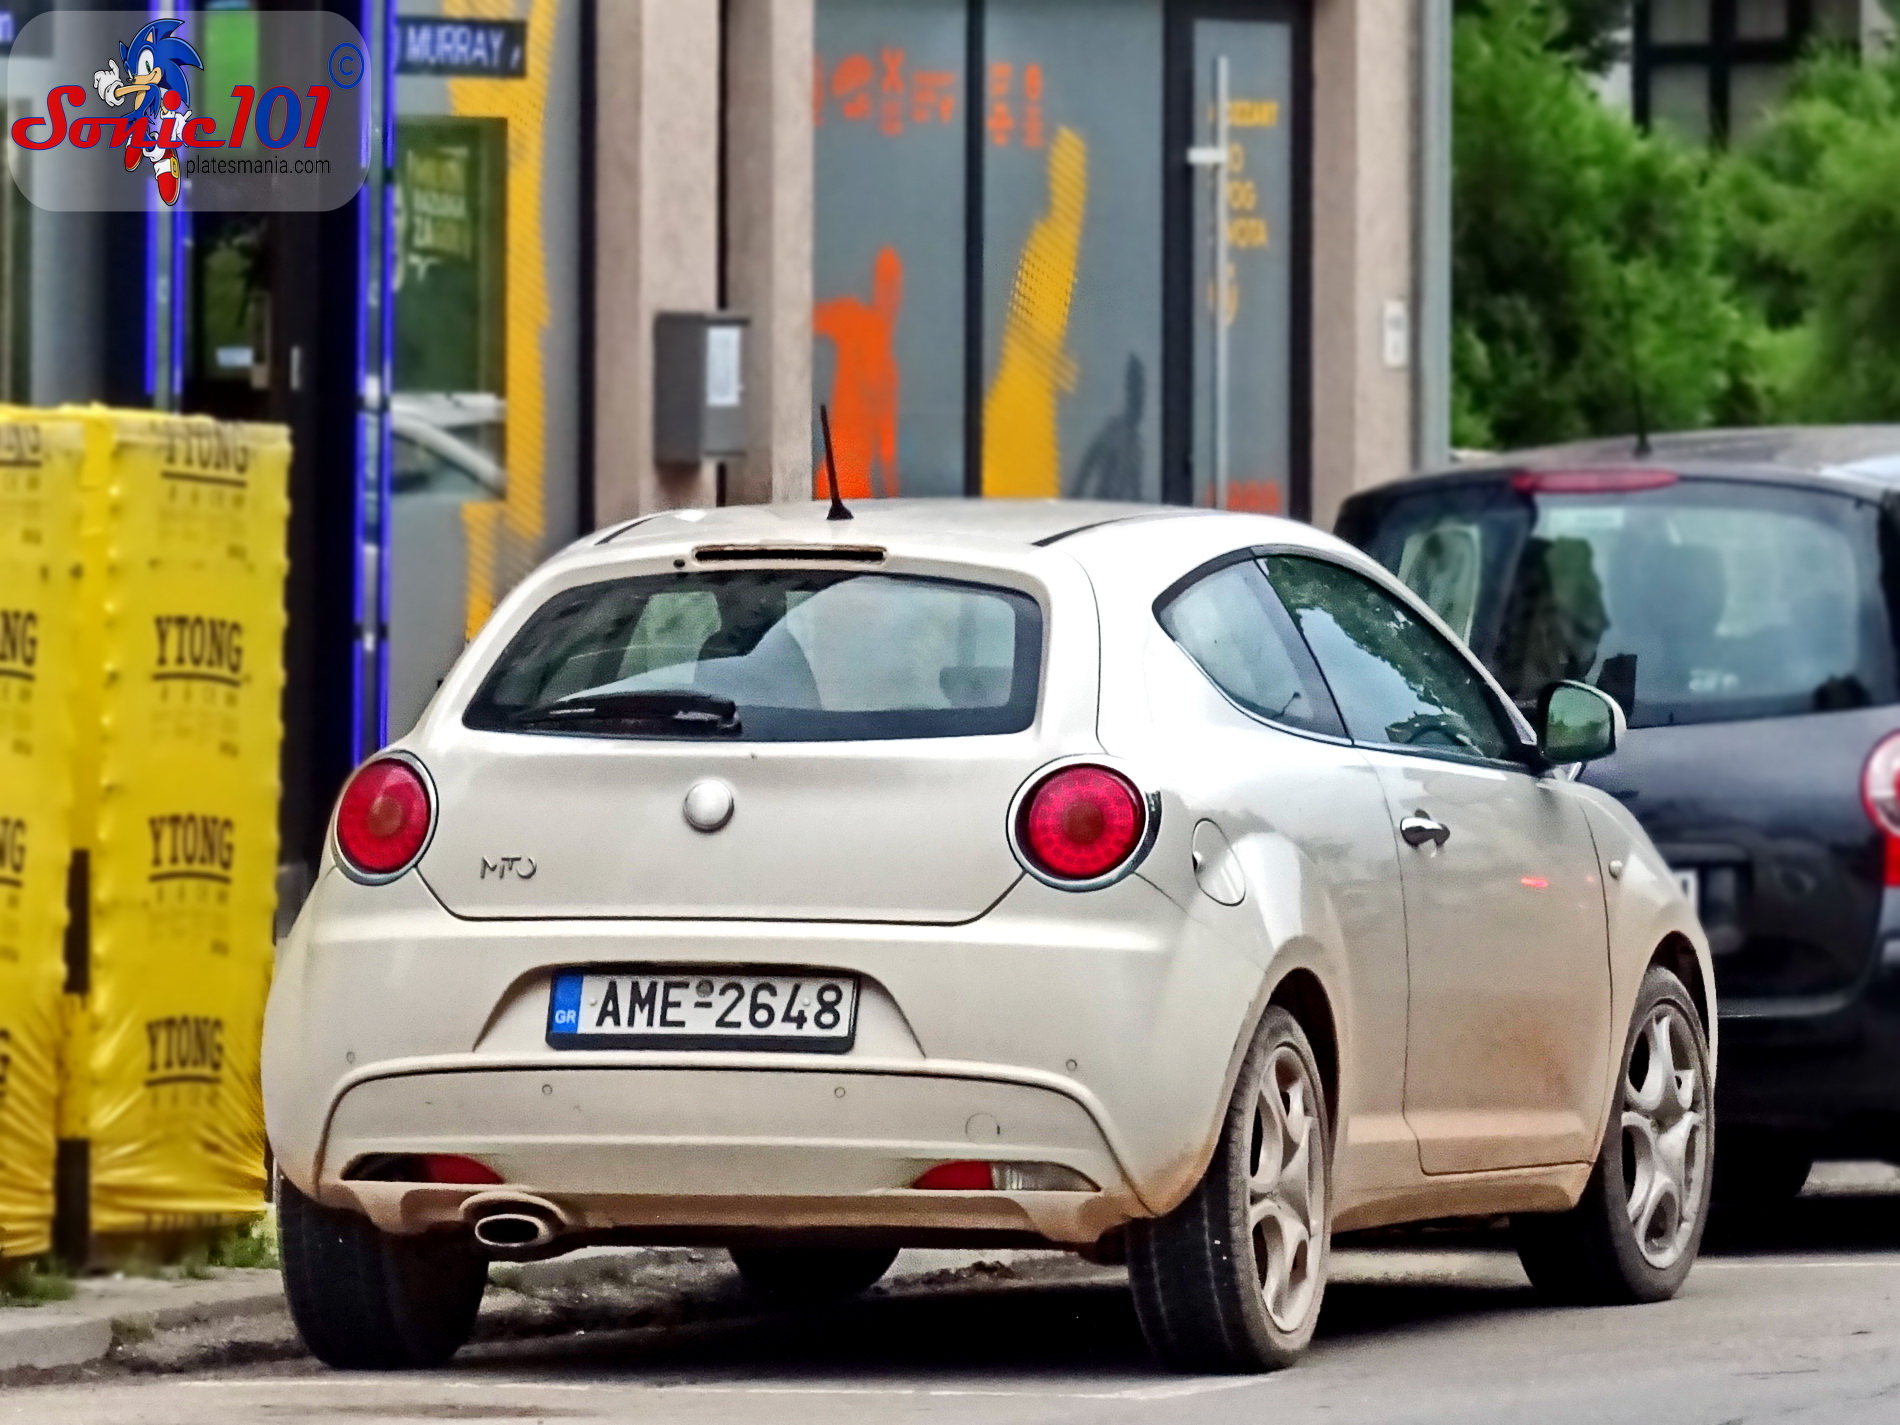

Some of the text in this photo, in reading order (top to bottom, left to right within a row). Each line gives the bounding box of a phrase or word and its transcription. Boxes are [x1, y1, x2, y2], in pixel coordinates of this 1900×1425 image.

[407, 24, 505, 67] MURRAY
[153, 614, 244, 675] YTONG
[148, 813, 235, 871] YTONG
[554, 980, 843, 1030] GR AME-2648
[145, 1014, 224, 1073] YTONG
